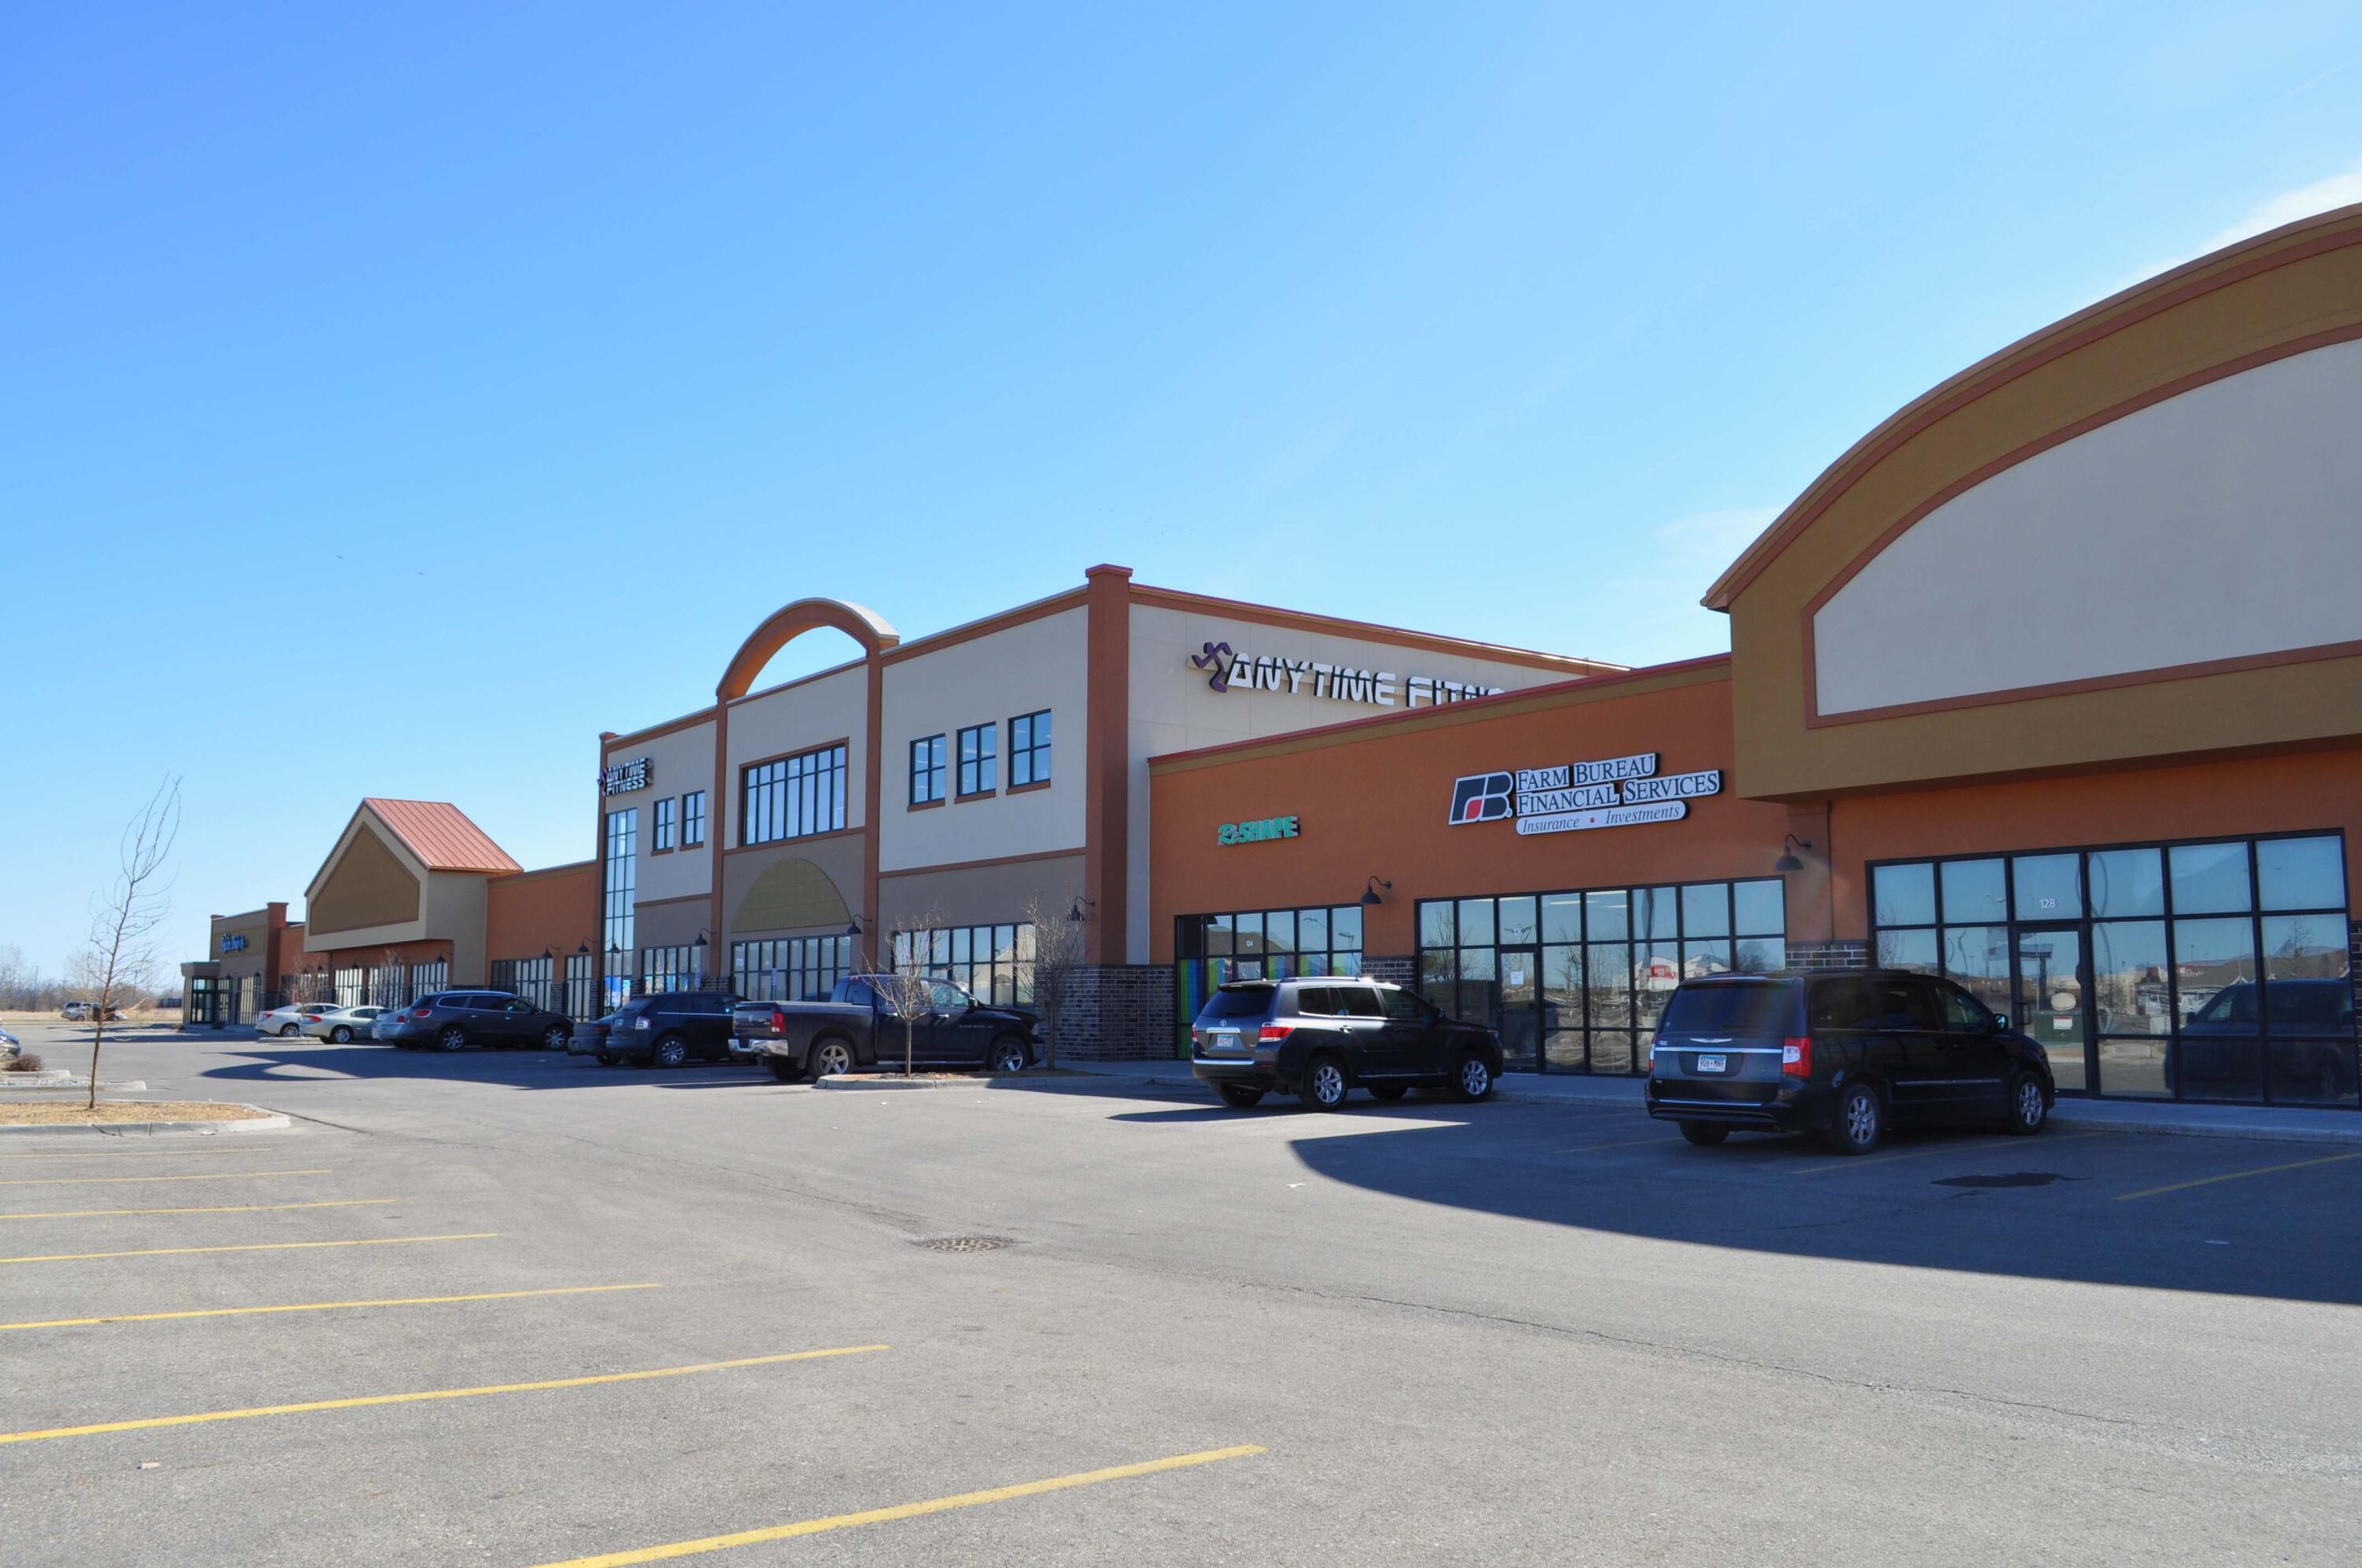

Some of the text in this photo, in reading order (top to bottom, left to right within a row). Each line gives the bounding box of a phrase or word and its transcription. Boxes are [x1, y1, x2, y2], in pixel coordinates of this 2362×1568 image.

[1225, 653, 1505, 708] ANYTIME FITN
[606, 757, 646, 782] ANYTIME
[1517, 756, 1654, 791] FARM BUREAU
[606, 774, 646, 797] FITNESS
[1518, 772, 1719, 814] FINANCIAL SERVICES
[1522, 804, 1680, 833] Insurance Investments
[2041, 898, 2056, 908] 128
